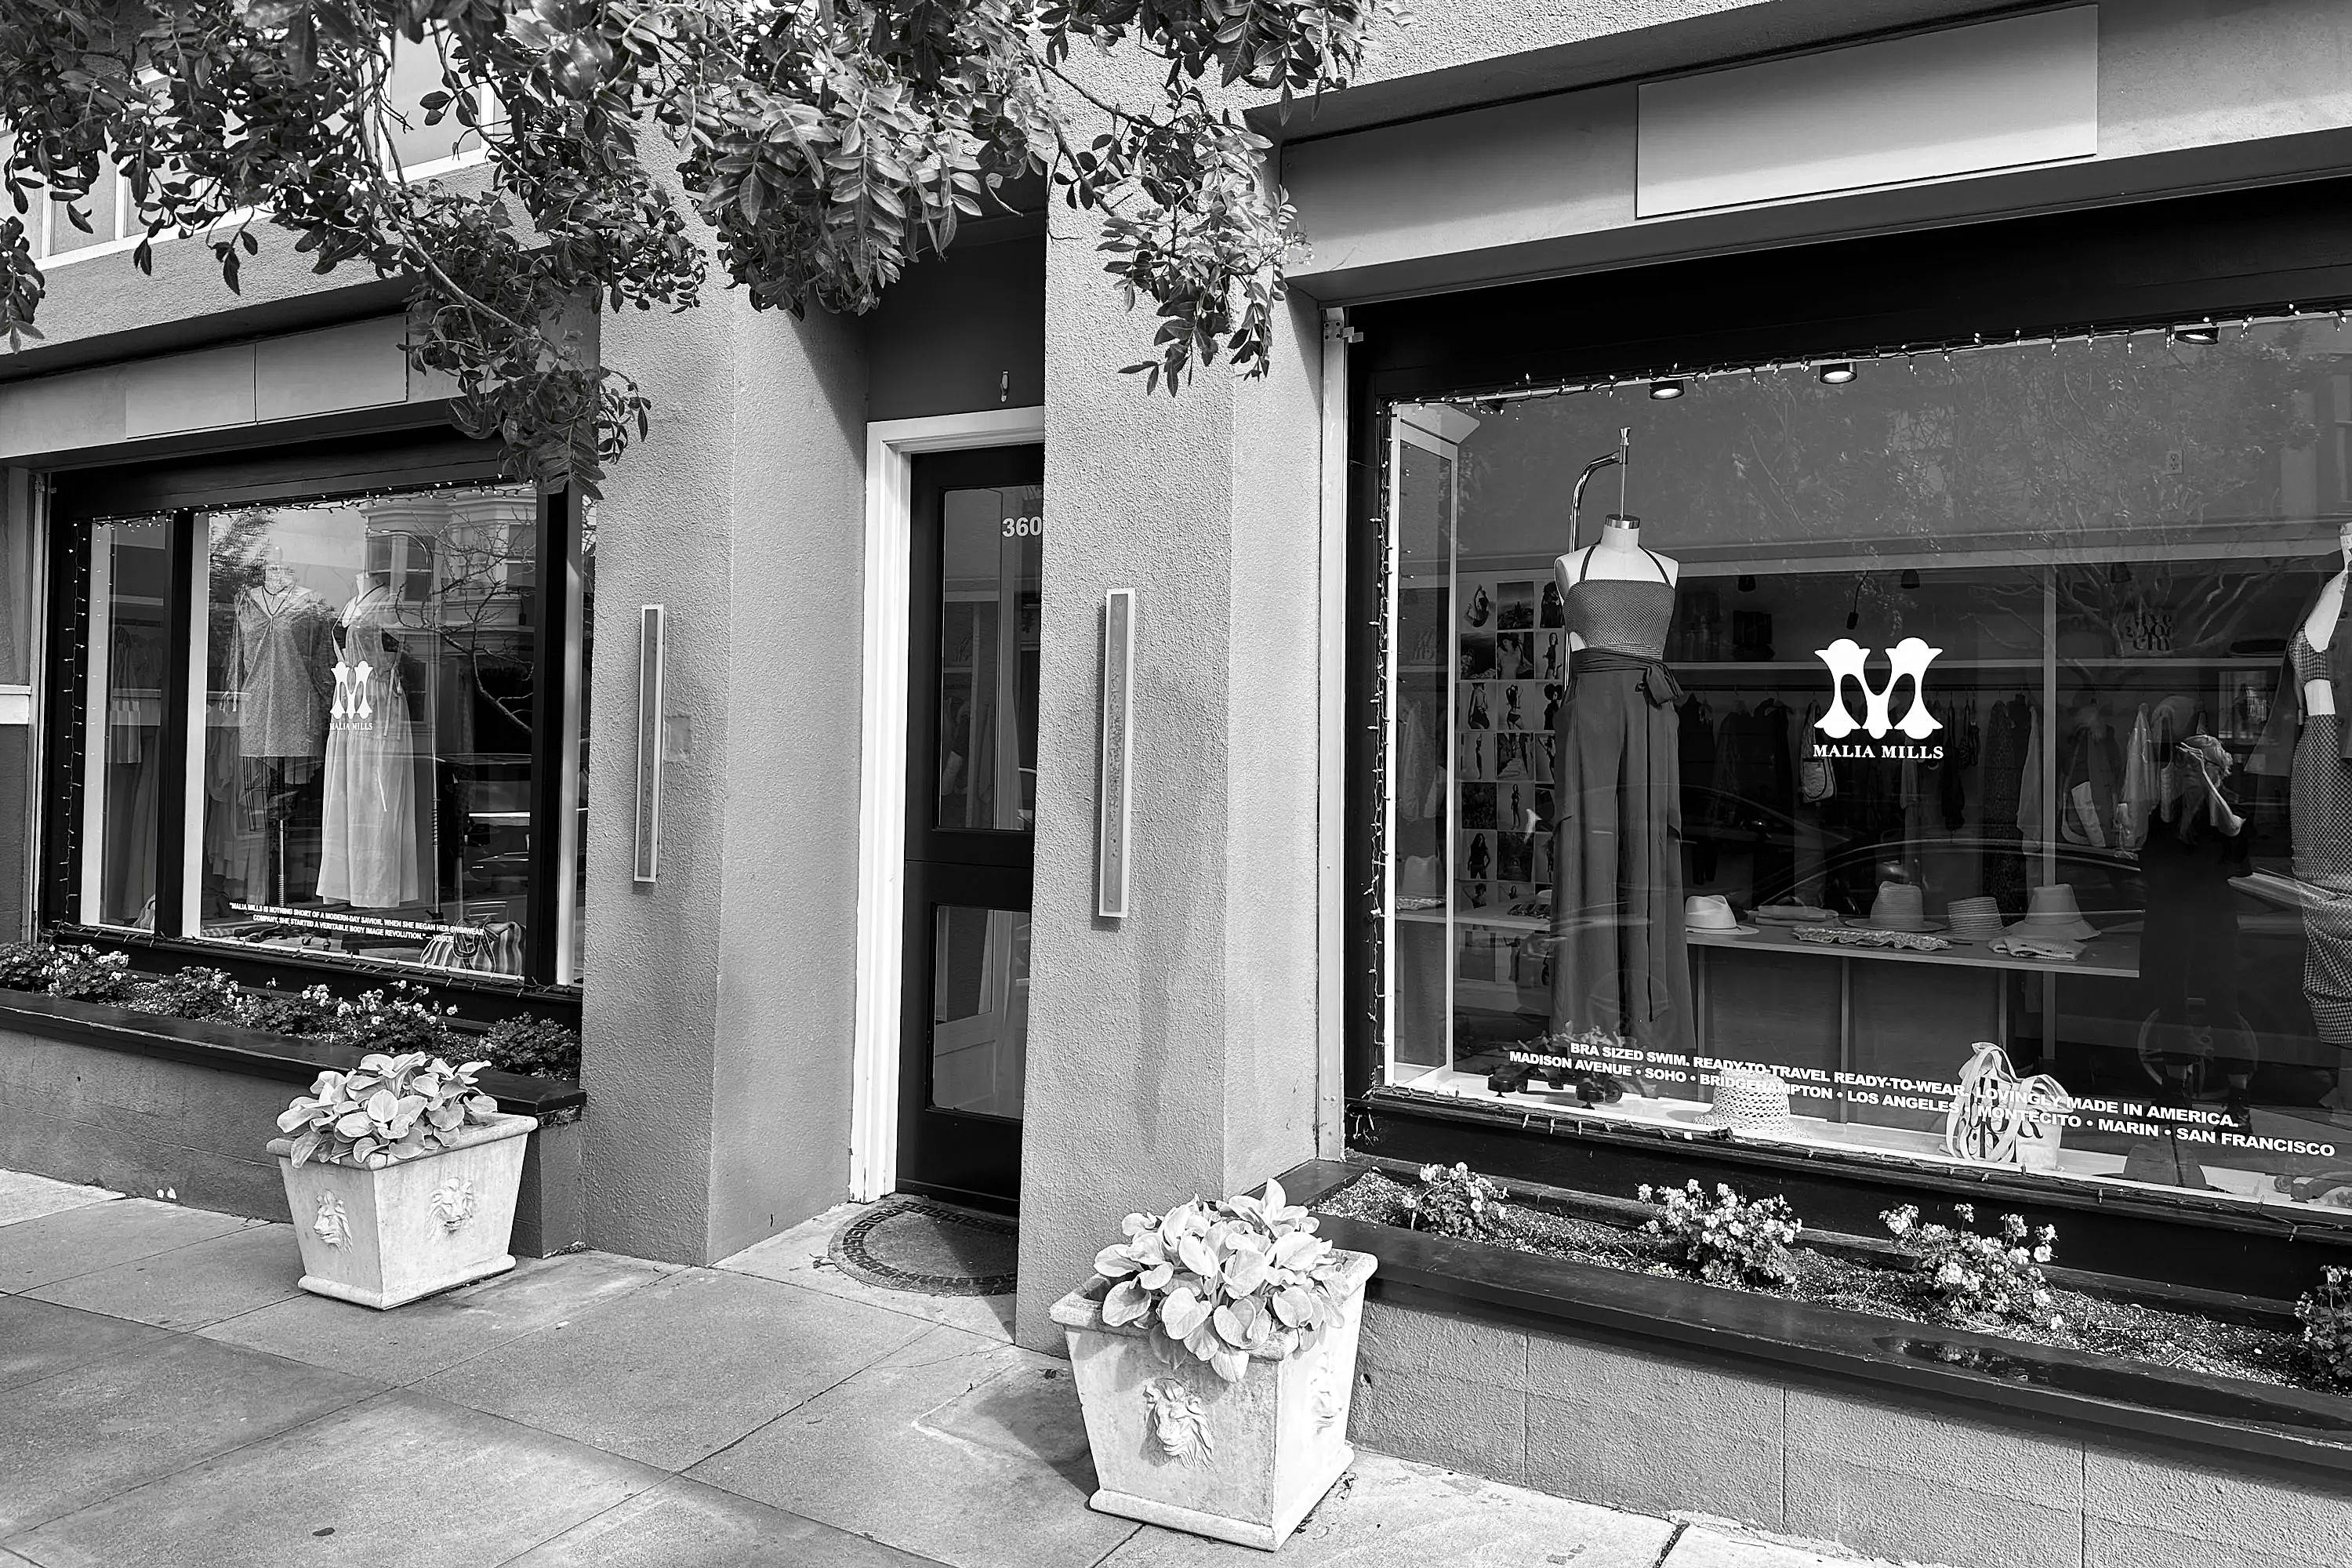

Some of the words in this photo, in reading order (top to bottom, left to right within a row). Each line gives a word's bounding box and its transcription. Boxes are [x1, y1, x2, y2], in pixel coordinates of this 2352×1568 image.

[1002, 516, 1043, 538] 360
[1813, 744, 1875, 758] MALIA
[1881, 745, 1944, 760] MILLS
[252, 914, 279, 924] COMPANY,
[290, 918, 314, 927] STARTED
[319, 921, 349, 931] VERITABLE
[349, 925, 365, 934] BODY
[365, 927, 384, 936] IMAGE
[269, 906, 292, 915] NOTHING
[293, 909, 311, 917] SHORT
[325, 912, 361, 923] MODERN-DAY
[361, 916, 383, 926] SAVIOR.
[383, 919, 401, 927] WHEN
[415, 922, 435, 931] BEGAN
[450, 925, 485, 936] SWIMWEAR
[1570, 1043, 1599, 1057] BRA
[1602, 1046, 1644, 1062] SIZED
[1646, 1051, 1690, 1067] SWIM.
[1976, 1087, 2063, 1107] LOVINGLY
[2066, 1096, 2118, 1114] MADE
[2123, 1102, 2143, 1116] IN
[2147, 1105, 2239, 1127] AMERICA.
[1509, 1051, 1572, 1069] MADISON
[1574, 1058, 1632, 1076] AVENUE
[1645, 1067, 1686, 1083] SOHO
[1700, 1073, 1833, 1099] BRIDGEHAMPTON
[1847, 1090, 1878, 1105] LOS
[1882, 1094, 1960, 1113] ANGELES
[1977, 1105, 2082, 1127] MONTECITO
[2098, 1118, 2159, 1137] MARIN
[2176, 1127, 2216, 1144] SAN
[2221, 1132, 2336, 1157] FRANCISCO
